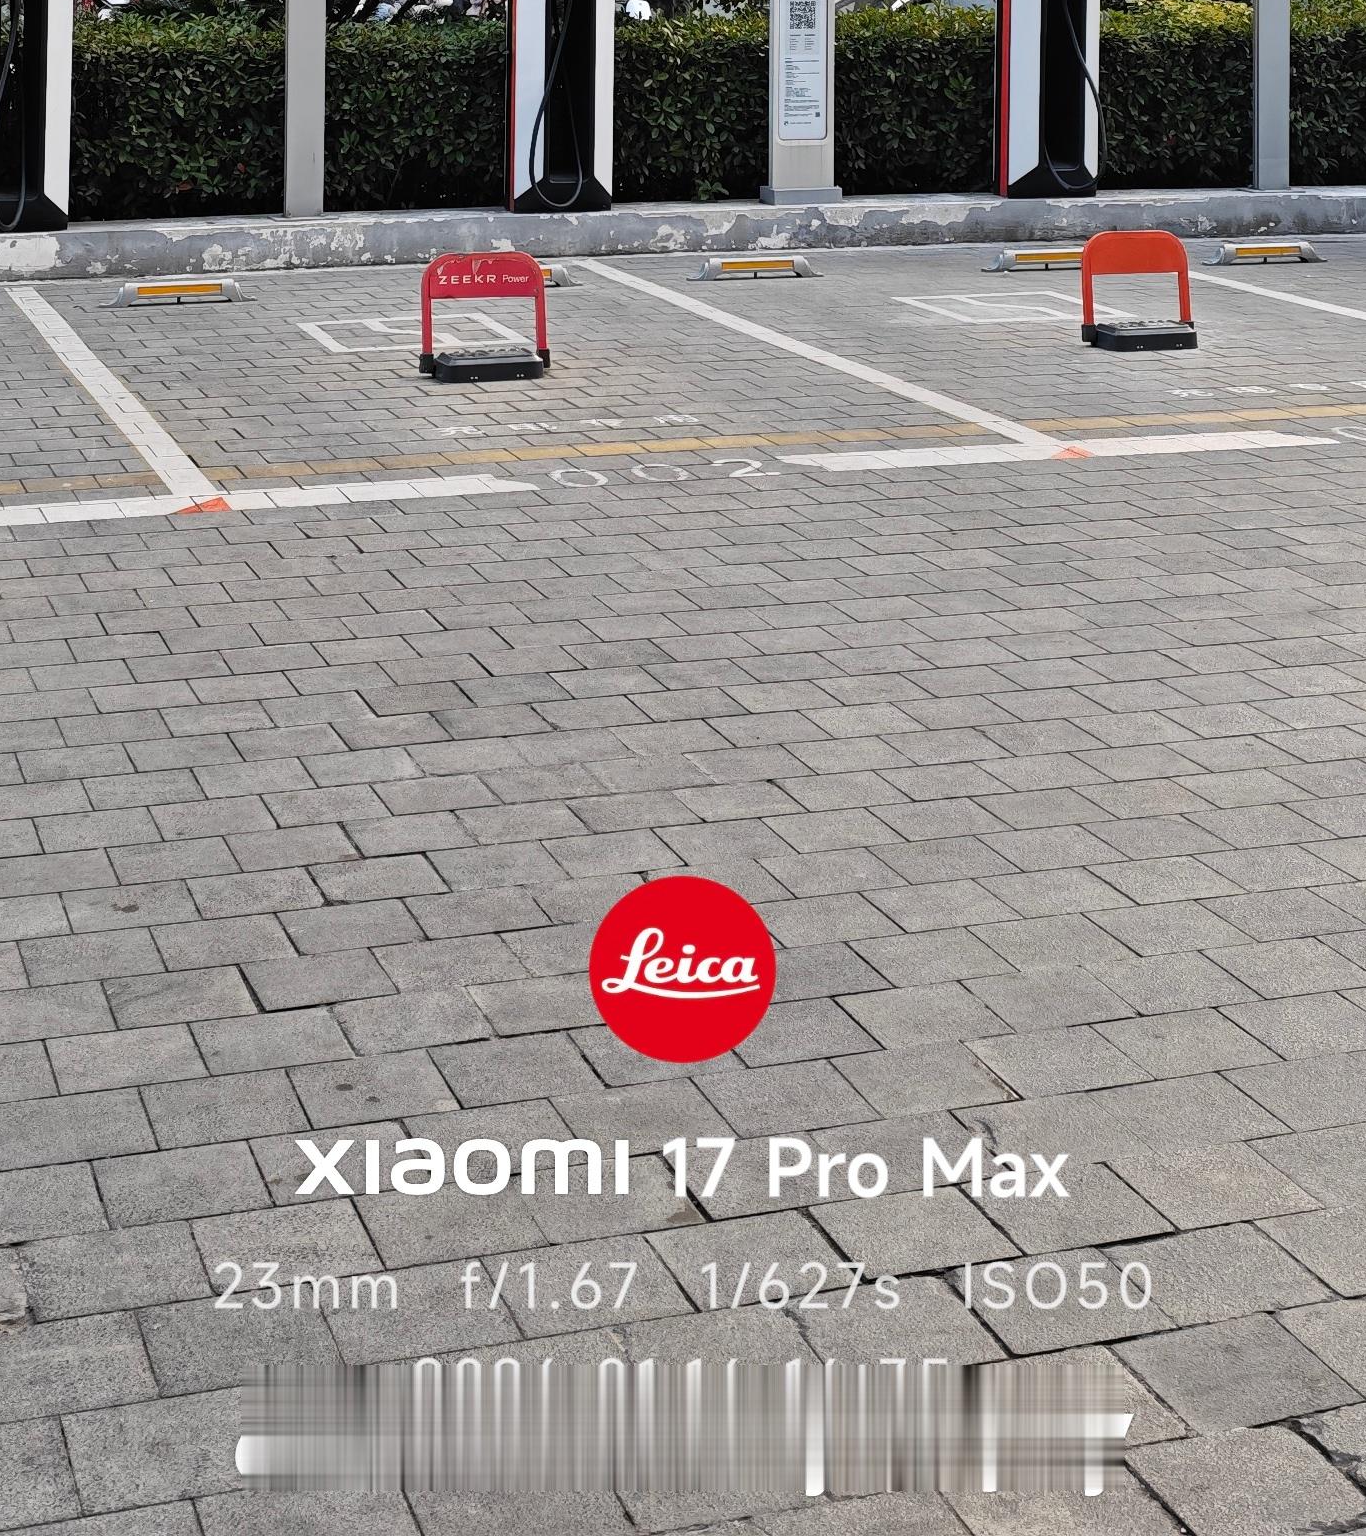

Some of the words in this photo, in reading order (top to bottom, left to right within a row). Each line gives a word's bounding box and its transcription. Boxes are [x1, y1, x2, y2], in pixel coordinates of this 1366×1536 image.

[438, 274, 496, 285] ZEEKR
[502, 274, 530, 283] Power
[547, 458, 781, 488] 002
